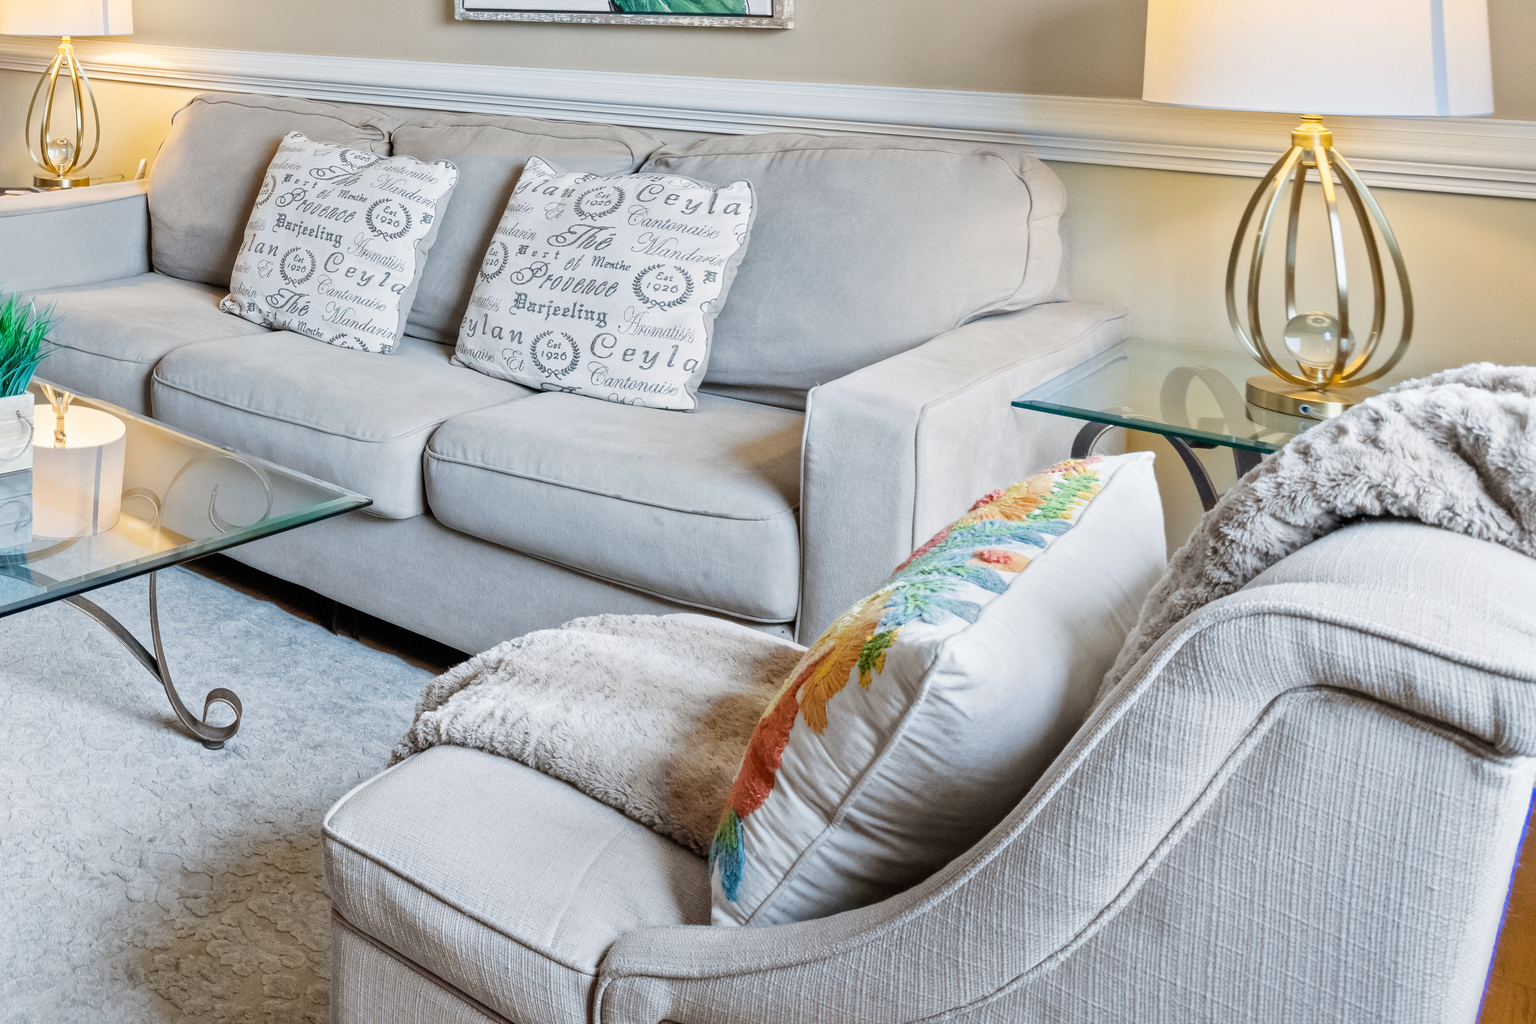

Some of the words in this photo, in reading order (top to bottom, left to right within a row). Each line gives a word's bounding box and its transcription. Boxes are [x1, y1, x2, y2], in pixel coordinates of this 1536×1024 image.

[373, 160, 439, 184] Cantonaise
[275, 187, 357, 223] Provence
[337, 189, 369, 203] Menthe
[584, 199, 612, 207] 1926
[272, 212, 344, 248] Darjeeling
[375, 213, 400, 228] 1926
[627, 204, 720, 239] Cantonaise
[515, 244, 561, 260] Vert
[563, 254, 586, 271] et
[590, 255, 632, 272] Menthe
[630, 232, 726, 267] Mandarin
[287, 262, 307, 273] 1926
[510, 261, 620, 297] Provence
[317, 274, 387, 311] Cantonaise
[646, 282, 679, 294] 1926
[321, 301, 396, 340] Mandarin
[509, 291, 609, 329] Darjeeling
[502, 347, 525, 372] Et
[540, 350, 568, 361] 1926
[587, 360, 680, 397] Cantonaise
